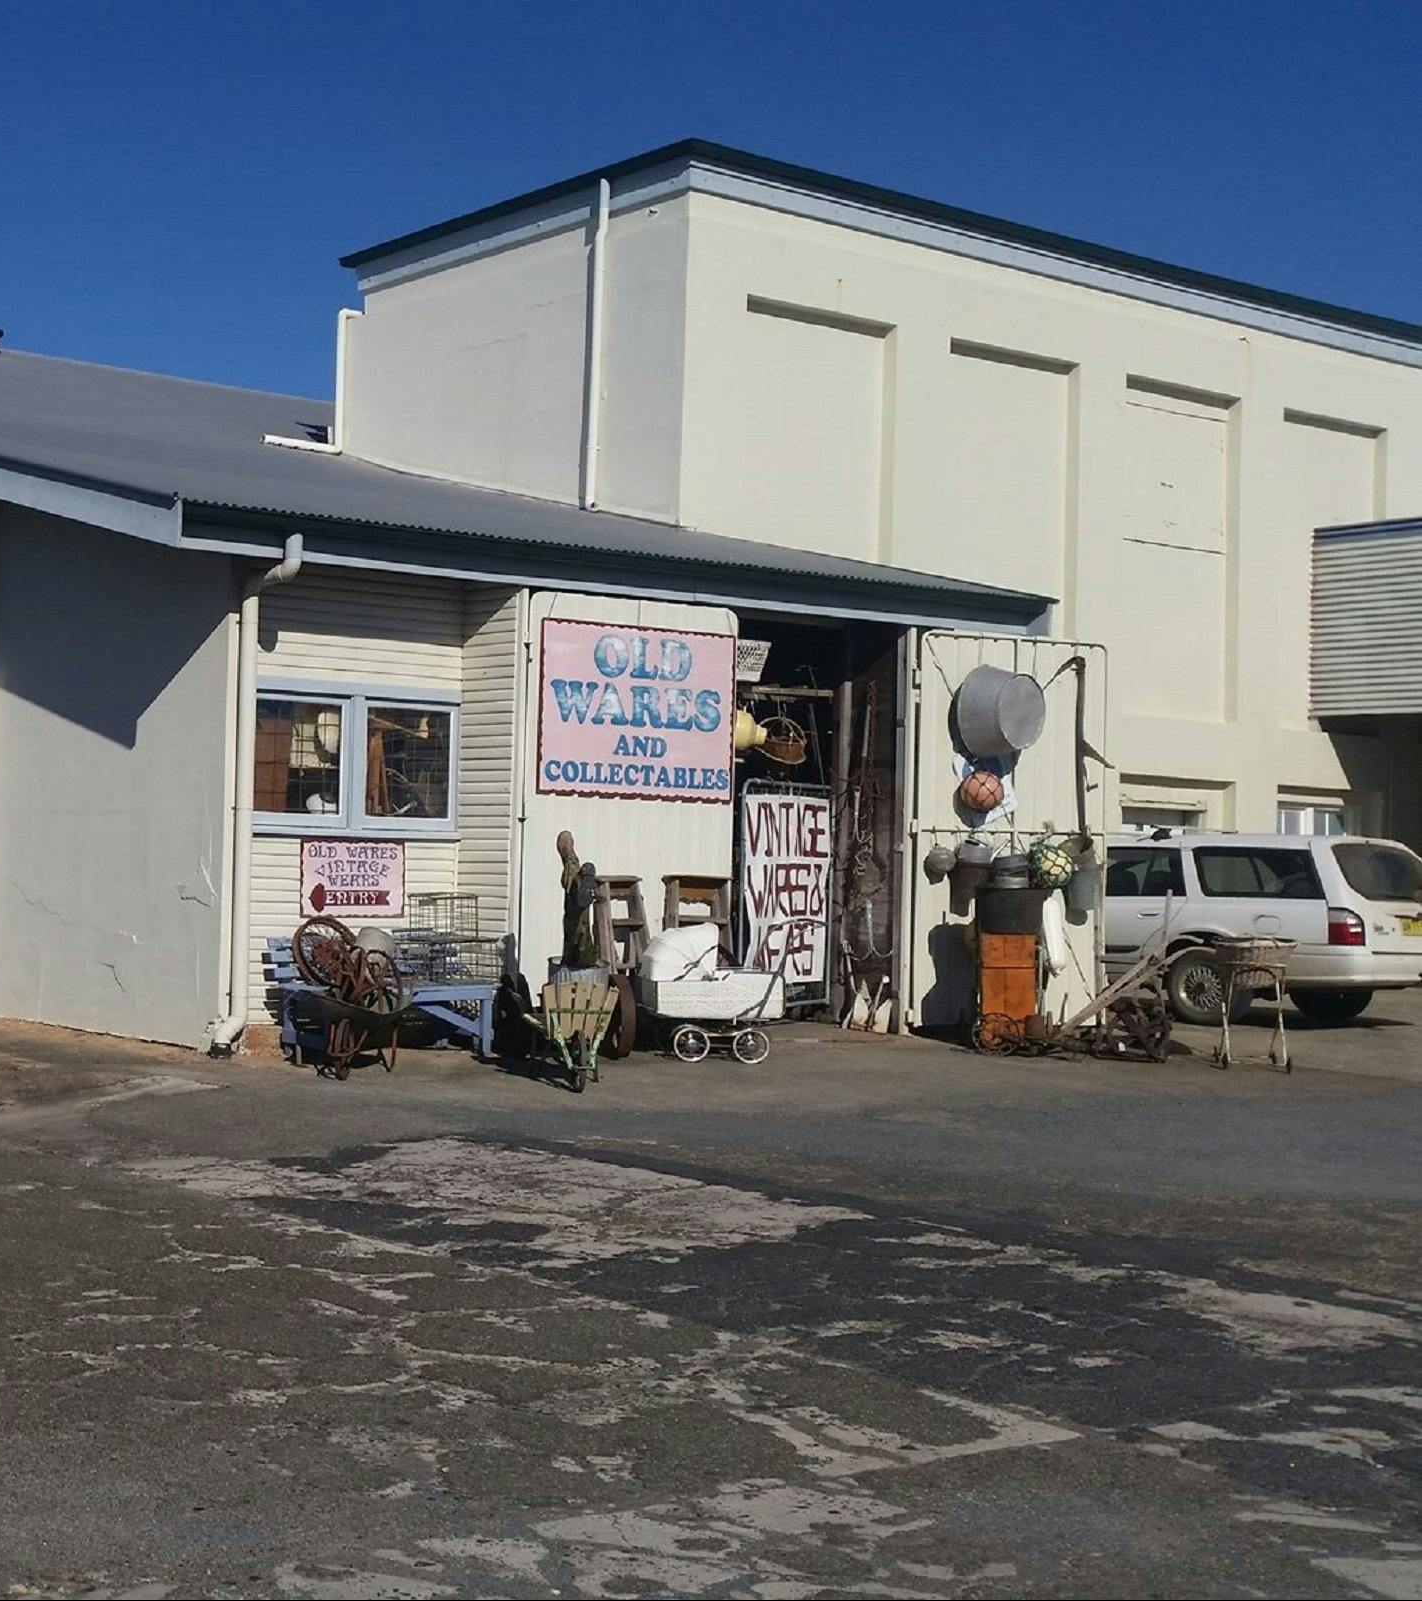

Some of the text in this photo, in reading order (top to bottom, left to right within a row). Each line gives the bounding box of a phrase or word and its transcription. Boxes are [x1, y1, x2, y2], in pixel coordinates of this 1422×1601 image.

[593, 634, 693, 682] OLD
[550, 678, 722, 733] WARES
[613, 734, 668, 759] AND
[544, 759, 729, 791] COLLECTABLES
[746, 802, 832, 858] VINTAGE
[308, 843, 398, 860] OLD WARES
[314, 860, 390, 878] VINTAGE
[327, 874, 379, 887] WEARS
[325, 891, 379, 905] ENTRY
[746, 863, 811, 918] WARES
